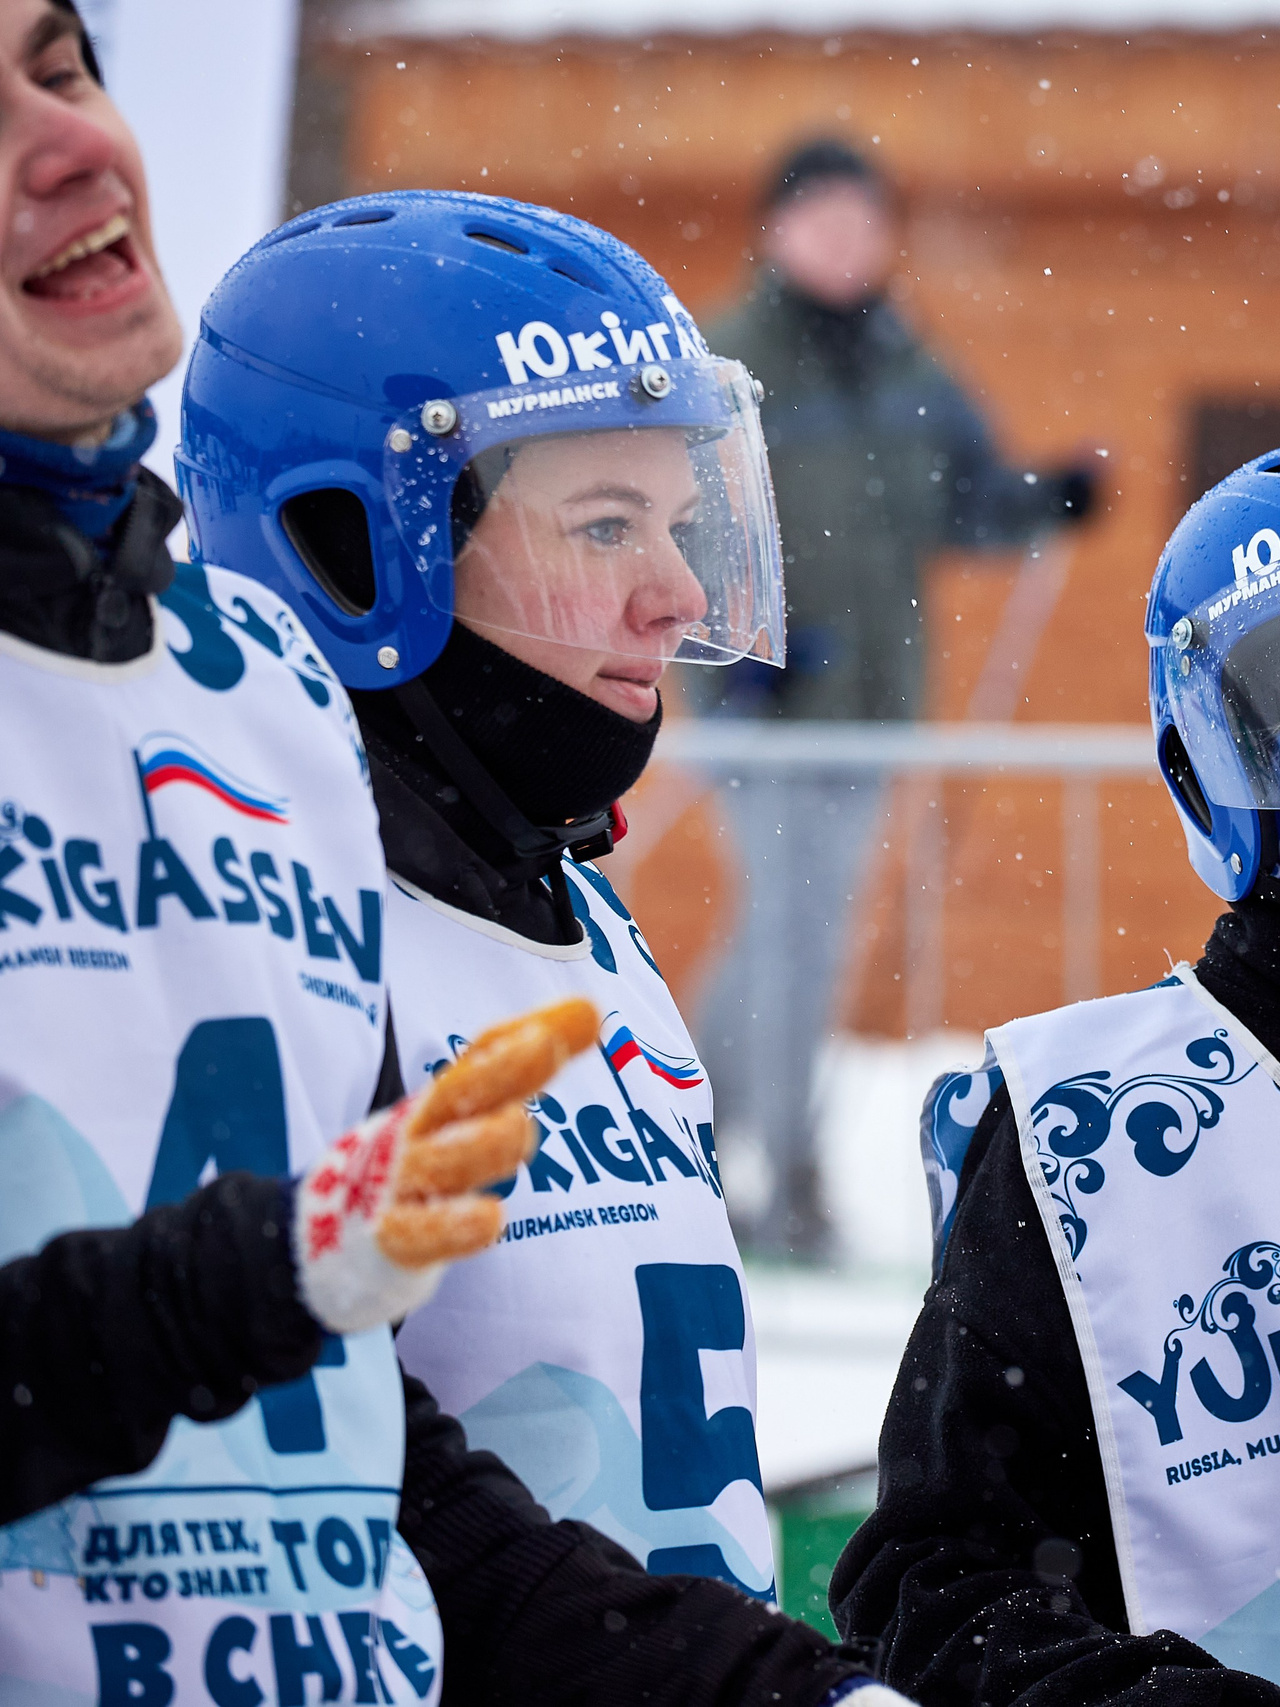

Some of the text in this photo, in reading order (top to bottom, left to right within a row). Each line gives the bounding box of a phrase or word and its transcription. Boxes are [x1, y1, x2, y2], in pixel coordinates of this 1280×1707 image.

[486, 381, 621, 419] МУРМАНСК
[598, 1203, 659, 1225] REGION
[635, 1262, 777, 1602] 5
[1166, 1448, 1243, 1486] RUSSIA,
[84, 1519, 180, 1564] ДЛЯ
[82, 1566, 269, 1604] КТО ЗНАЕТ
[89, 1621, 176, 1707] В
